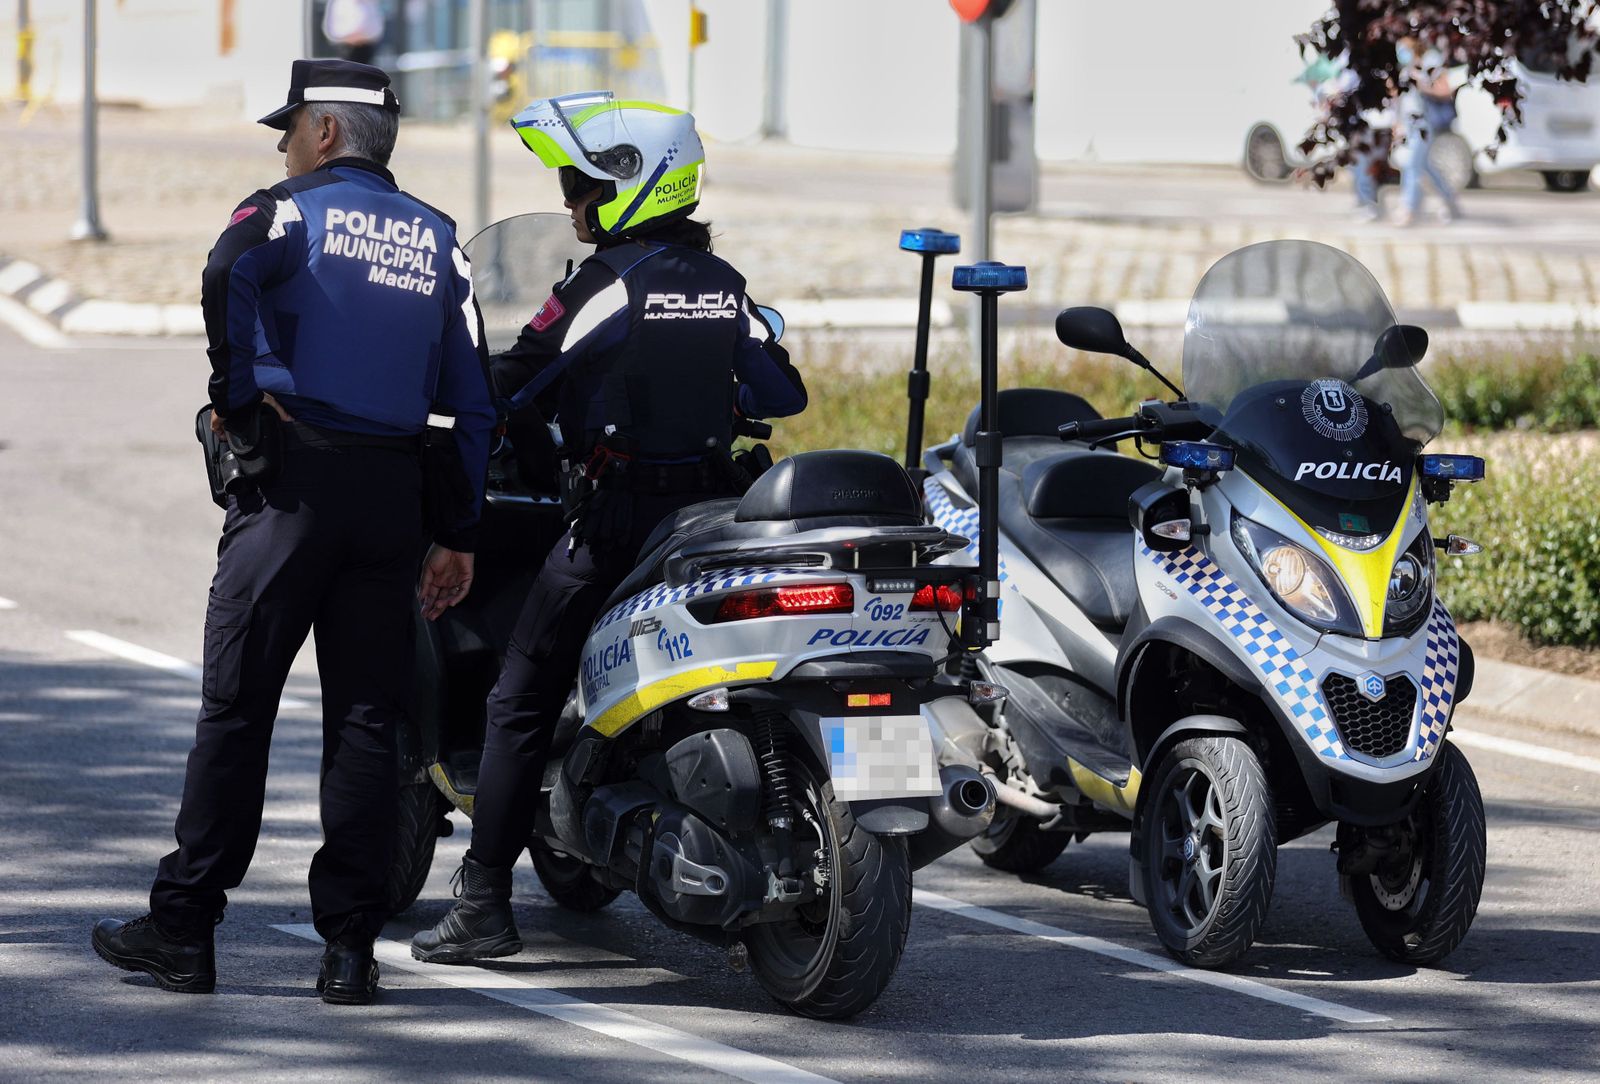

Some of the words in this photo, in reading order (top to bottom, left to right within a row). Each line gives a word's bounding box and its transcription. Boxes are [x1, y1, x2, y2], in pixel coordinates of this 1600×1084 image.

[655, 172, 696, 197] POLICÍA
[325, 208, 437, 253] POLICÍA
[323, 232, 437, 277] MUNICIPAL
[368, 265, 436, 296] Madrid
[644, 290, 738, 310] POLICÍA
[1294, 460, 1402, 484] POLICÍA
[871, 603, 904, 621] 092
[665, 632, 693, 661] 112
[806, 623, 931, 646] POLICÍA
[583, 635, 631, 685] POLICÍA
